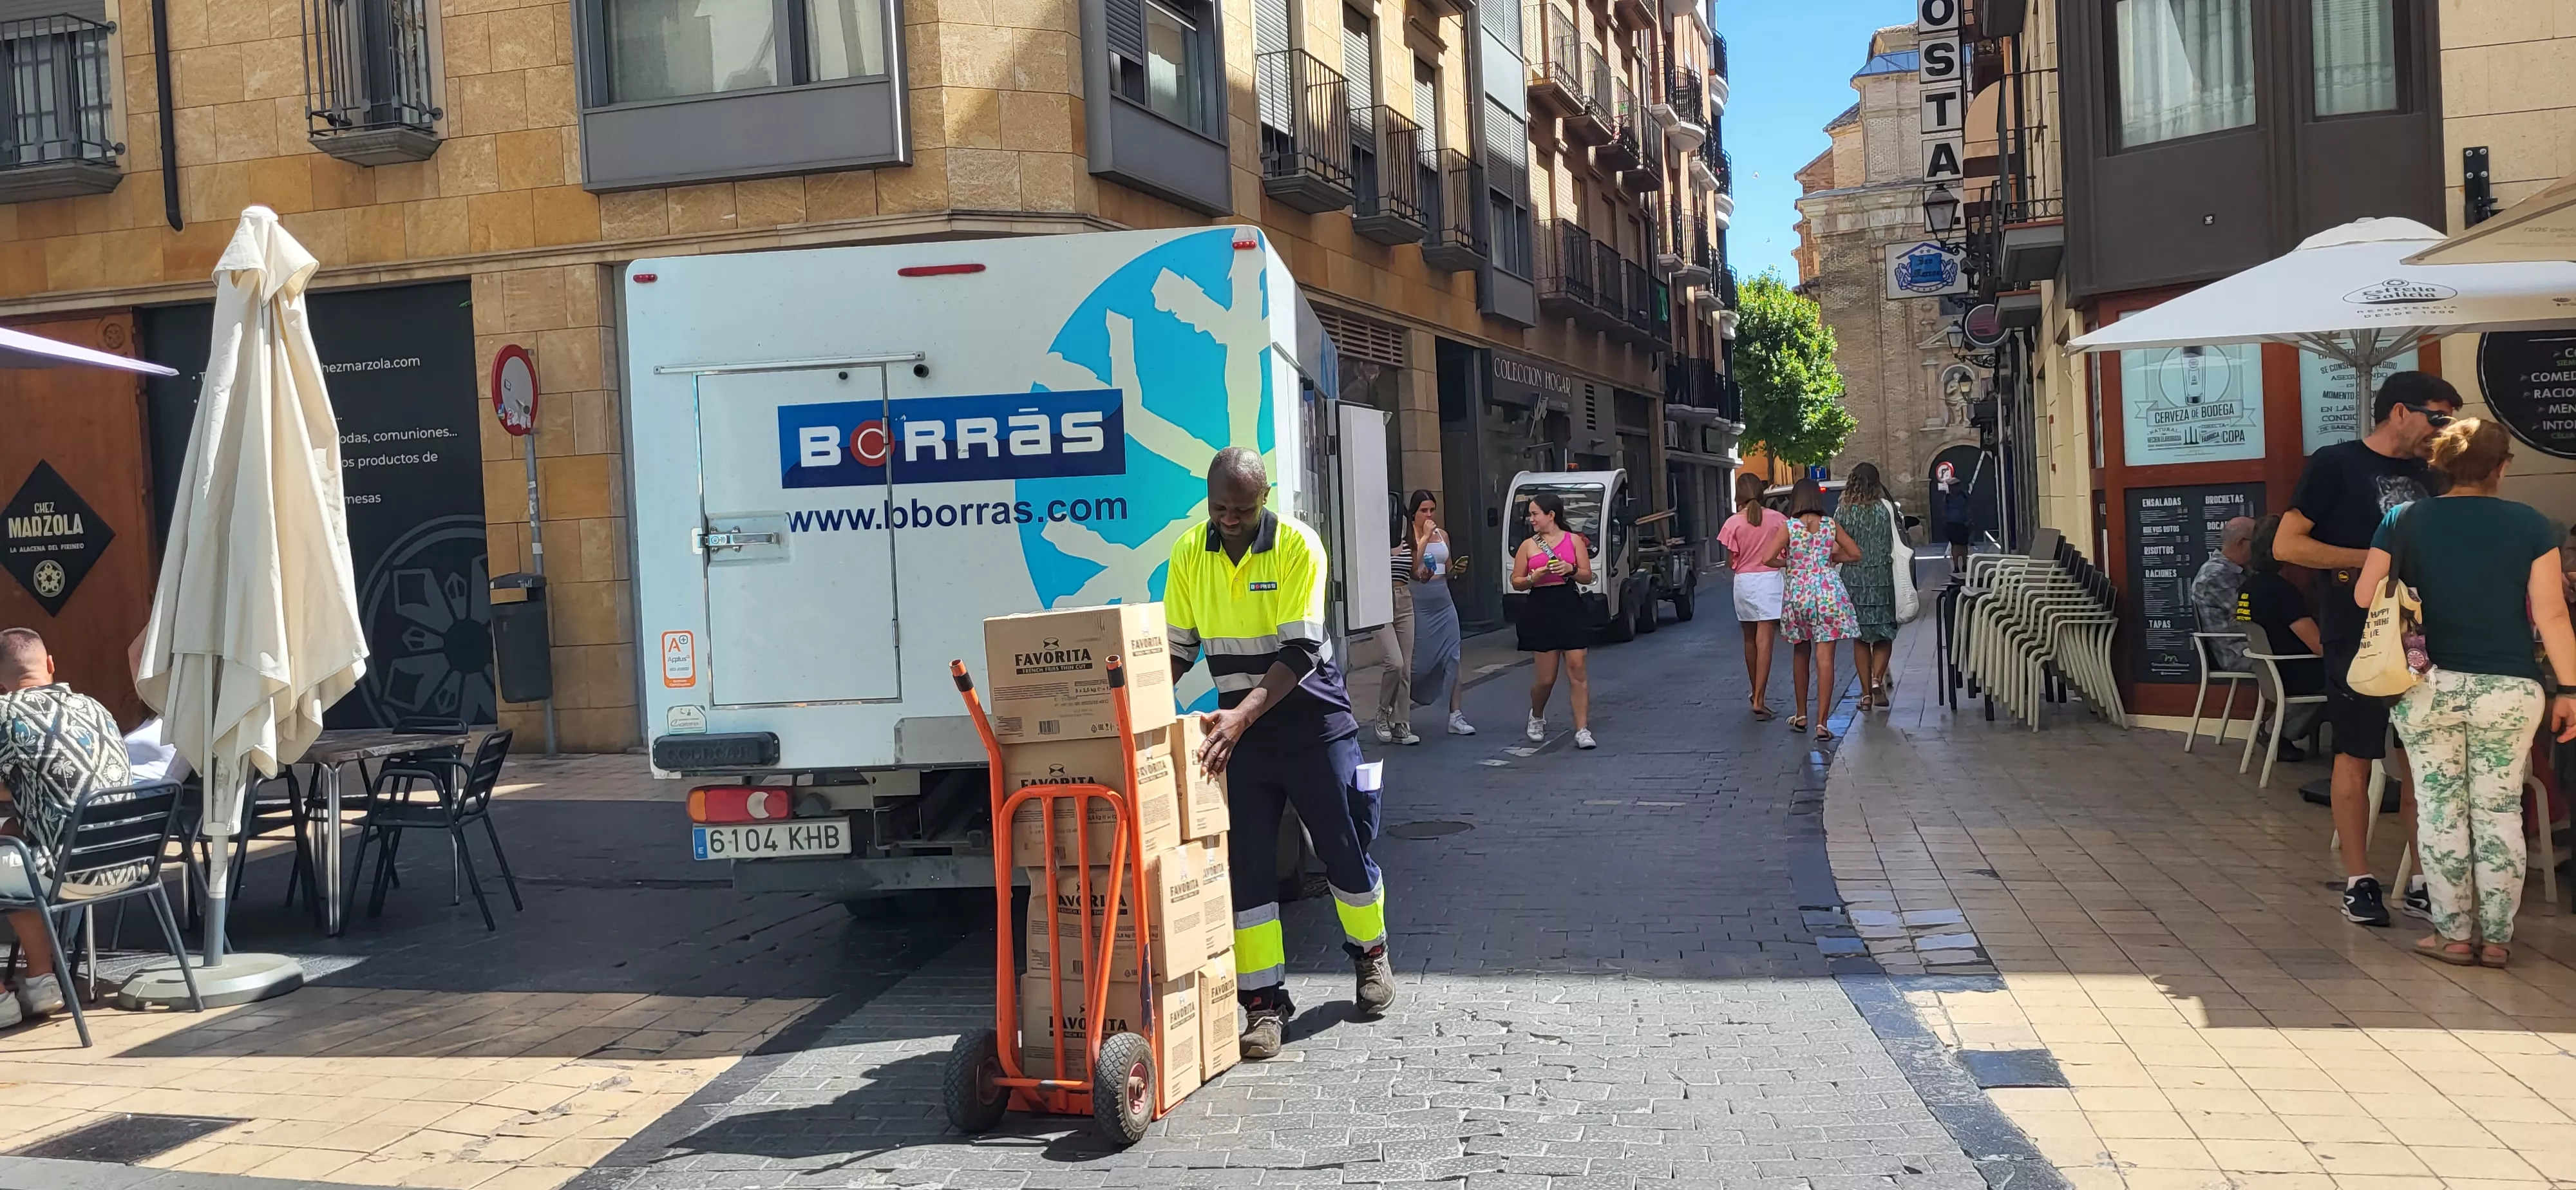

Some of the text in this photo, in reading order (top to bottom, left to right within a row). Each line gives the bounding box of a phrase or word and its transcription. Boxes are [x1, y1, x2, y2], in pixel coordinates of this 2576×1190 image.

[1922, 0, 1961, 225] OSTA
[2366, 292, 2436, 300] Galicia
[322, 357, 421, 373] hezmarzola.com
[1494, 357, 1571, 397] COLECCION HOGAR
[2322, 390, 2354, 399] MOMENTO
[2534, 388, 2576, 399] RACIO
[2155, 403, 2235, 423] CERVEZA DE BODEGA
[339, 432, 370, 444] odas,
[2222, 430, 2245, 443] COPA
[358, 453, 419, 469] productos
[422, 451, 438, 462] de
[2142, 497, 2181, 507] ENSALADAS
[2205, 495, 2244, 504] BROCHETAS
[34, 502, 55, 513] CHEZ
[786, 496, 1128, 533] www.bborras.com
[8, 513, 84, 538] MARZOLA
[2144, 546, 2174, 554] RISOTTOS
[2146, 569, 2177, 578] RACIONES
[2148, 619, 2171, 628] TAPAS
[1131, 636, 1162, 650] FAVORITA
[1015, 648, 1092, 666] FAVORITA
[710, 826, 840, 853] 6104 KHB
[1203, 863, 1225, 878] AVORITA
[1211, 978, 1235, 998] FAVORITA
[1170, 1001, 1195, 1023] FAVORITA
